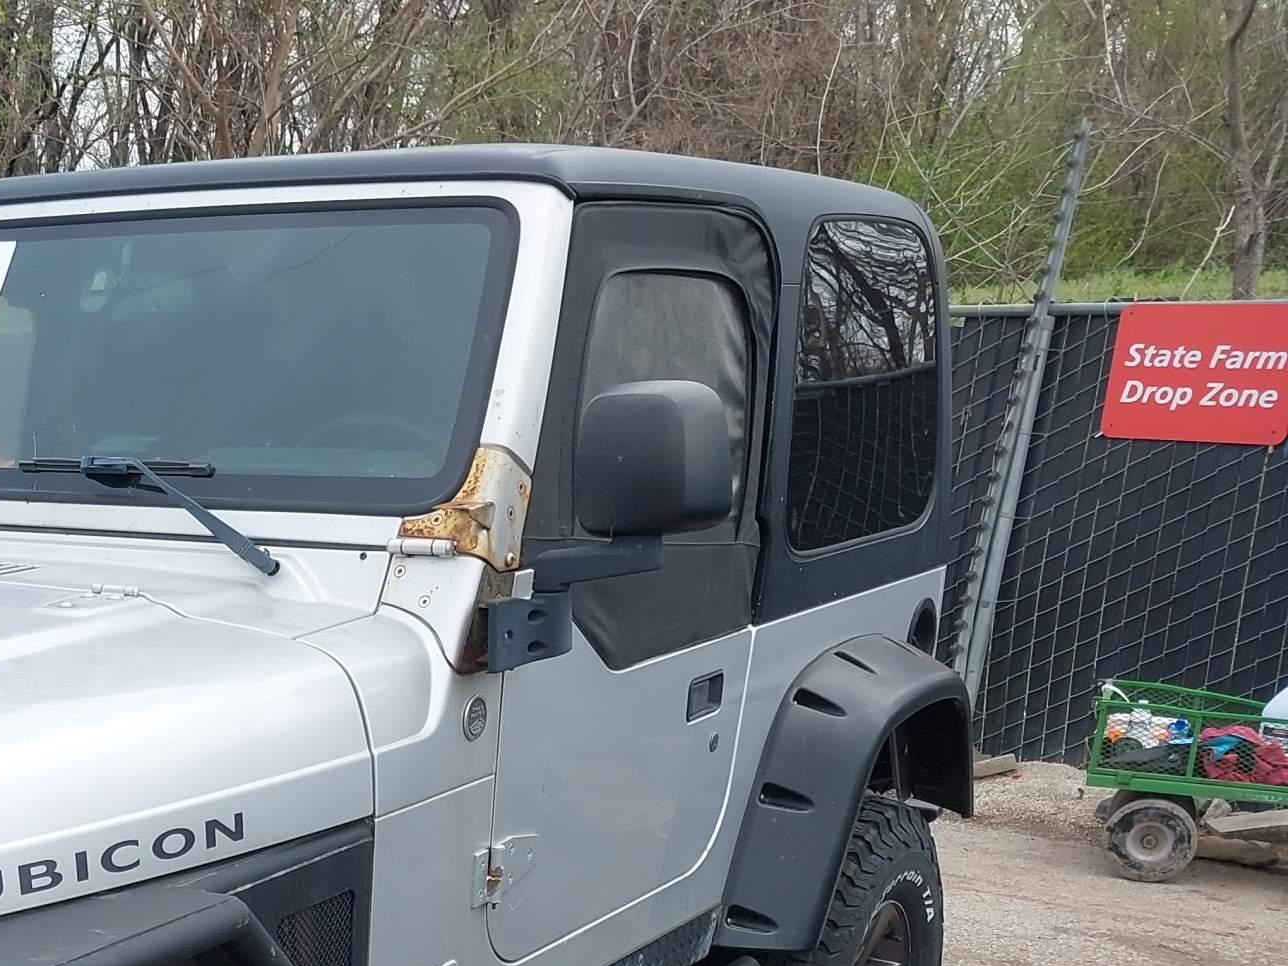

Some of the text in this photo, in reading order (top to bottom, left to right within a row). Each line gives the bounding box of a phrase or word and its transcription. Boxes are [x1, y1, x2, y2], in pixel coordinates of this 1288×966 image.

[1123, 342, 1288, 370] State Farm
[1119, 379, 1279, 411] Drop Zone
